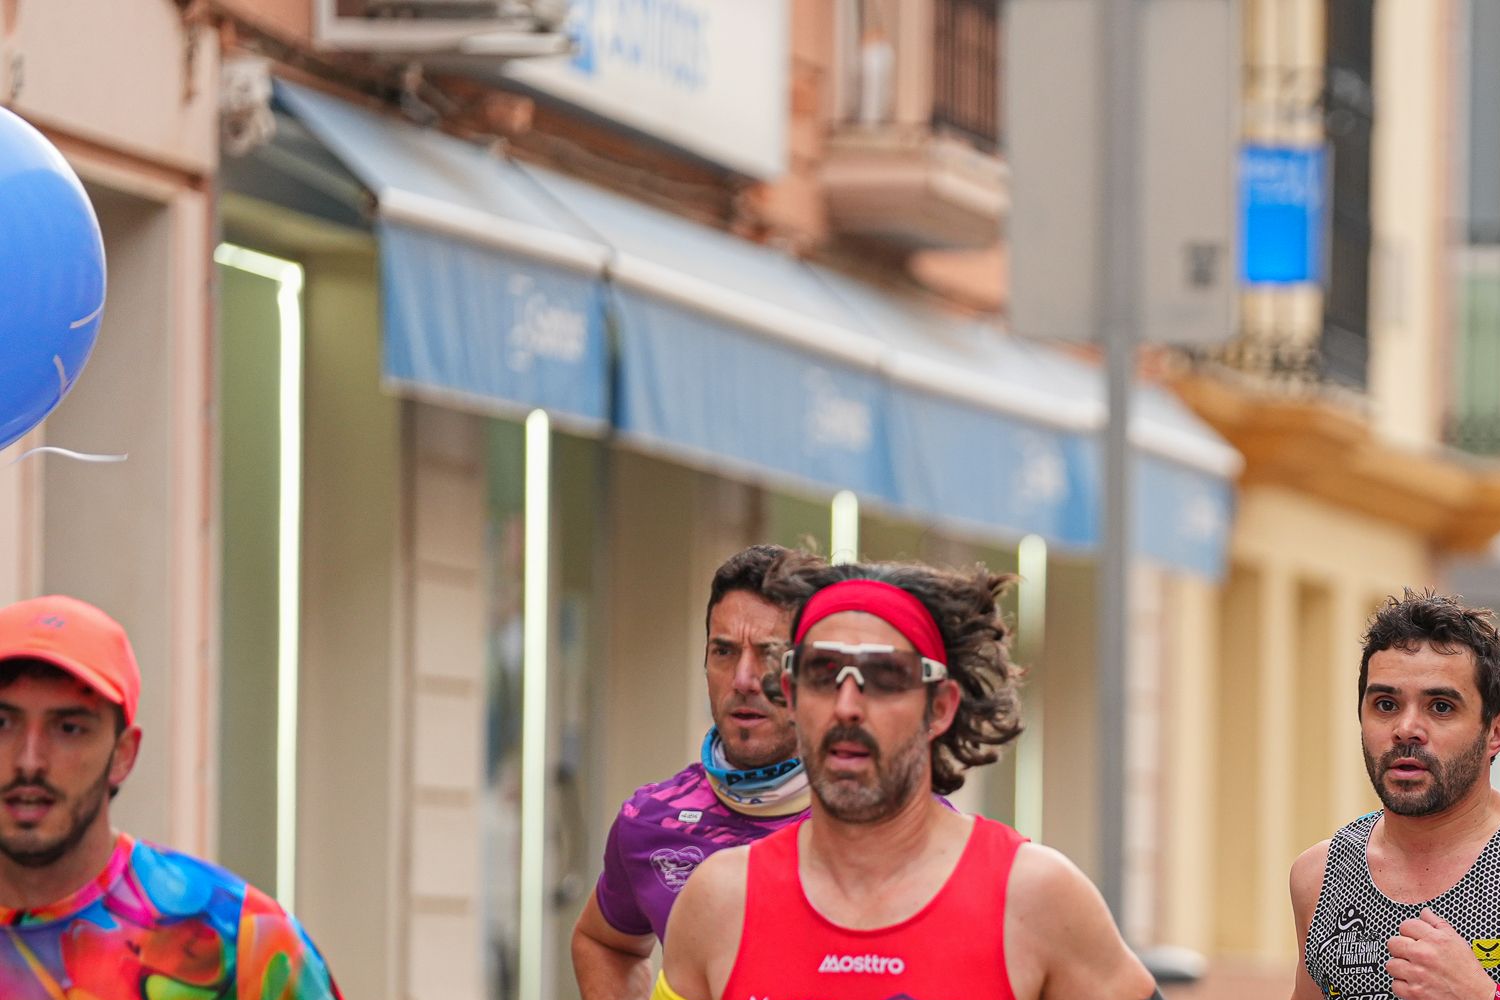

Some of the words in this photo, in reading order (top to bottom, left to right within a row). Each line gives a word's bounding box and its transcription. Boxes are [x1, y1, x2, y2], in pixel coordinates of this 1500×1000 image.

[1340, 931, 1357, 943] CLUB
[1337, 940, 1378, 954] ATLETISMO
[1340, 966, 1373, 975] LUCENA
